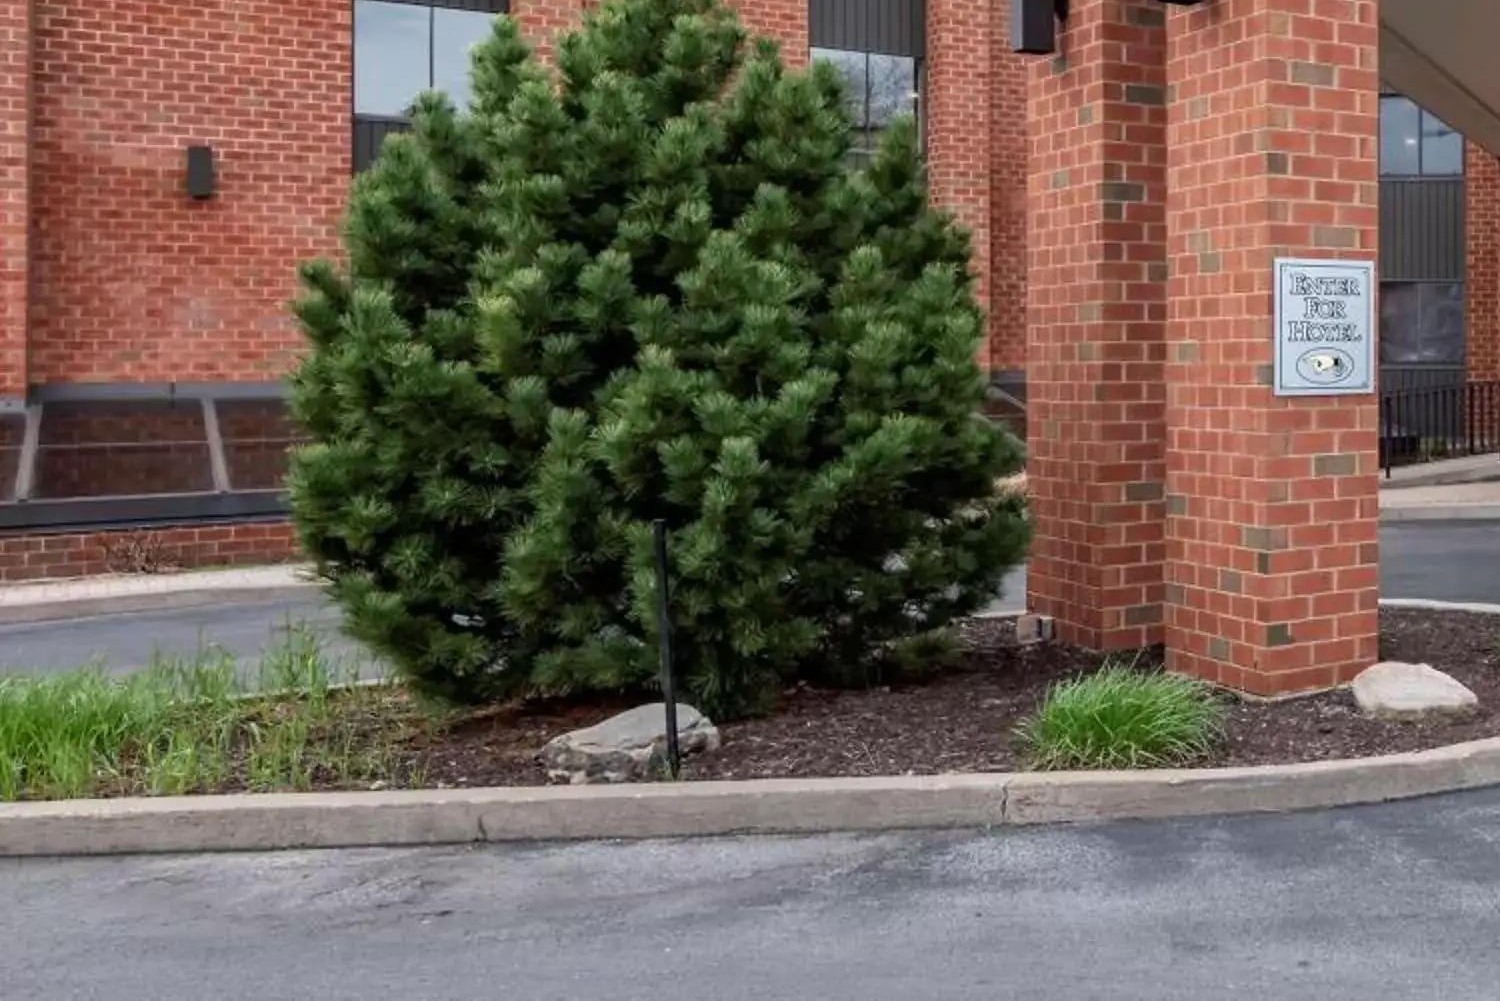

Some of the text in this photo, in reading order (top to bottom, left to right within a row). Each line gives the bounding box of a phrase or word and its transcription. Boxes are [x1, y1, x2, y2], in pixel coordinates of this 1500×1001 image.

[1289, 272, 1361, 296] ENTER
[1303, 296, 1347, 320] FOR
[1288, 320, 1363, 343] HOTEL
